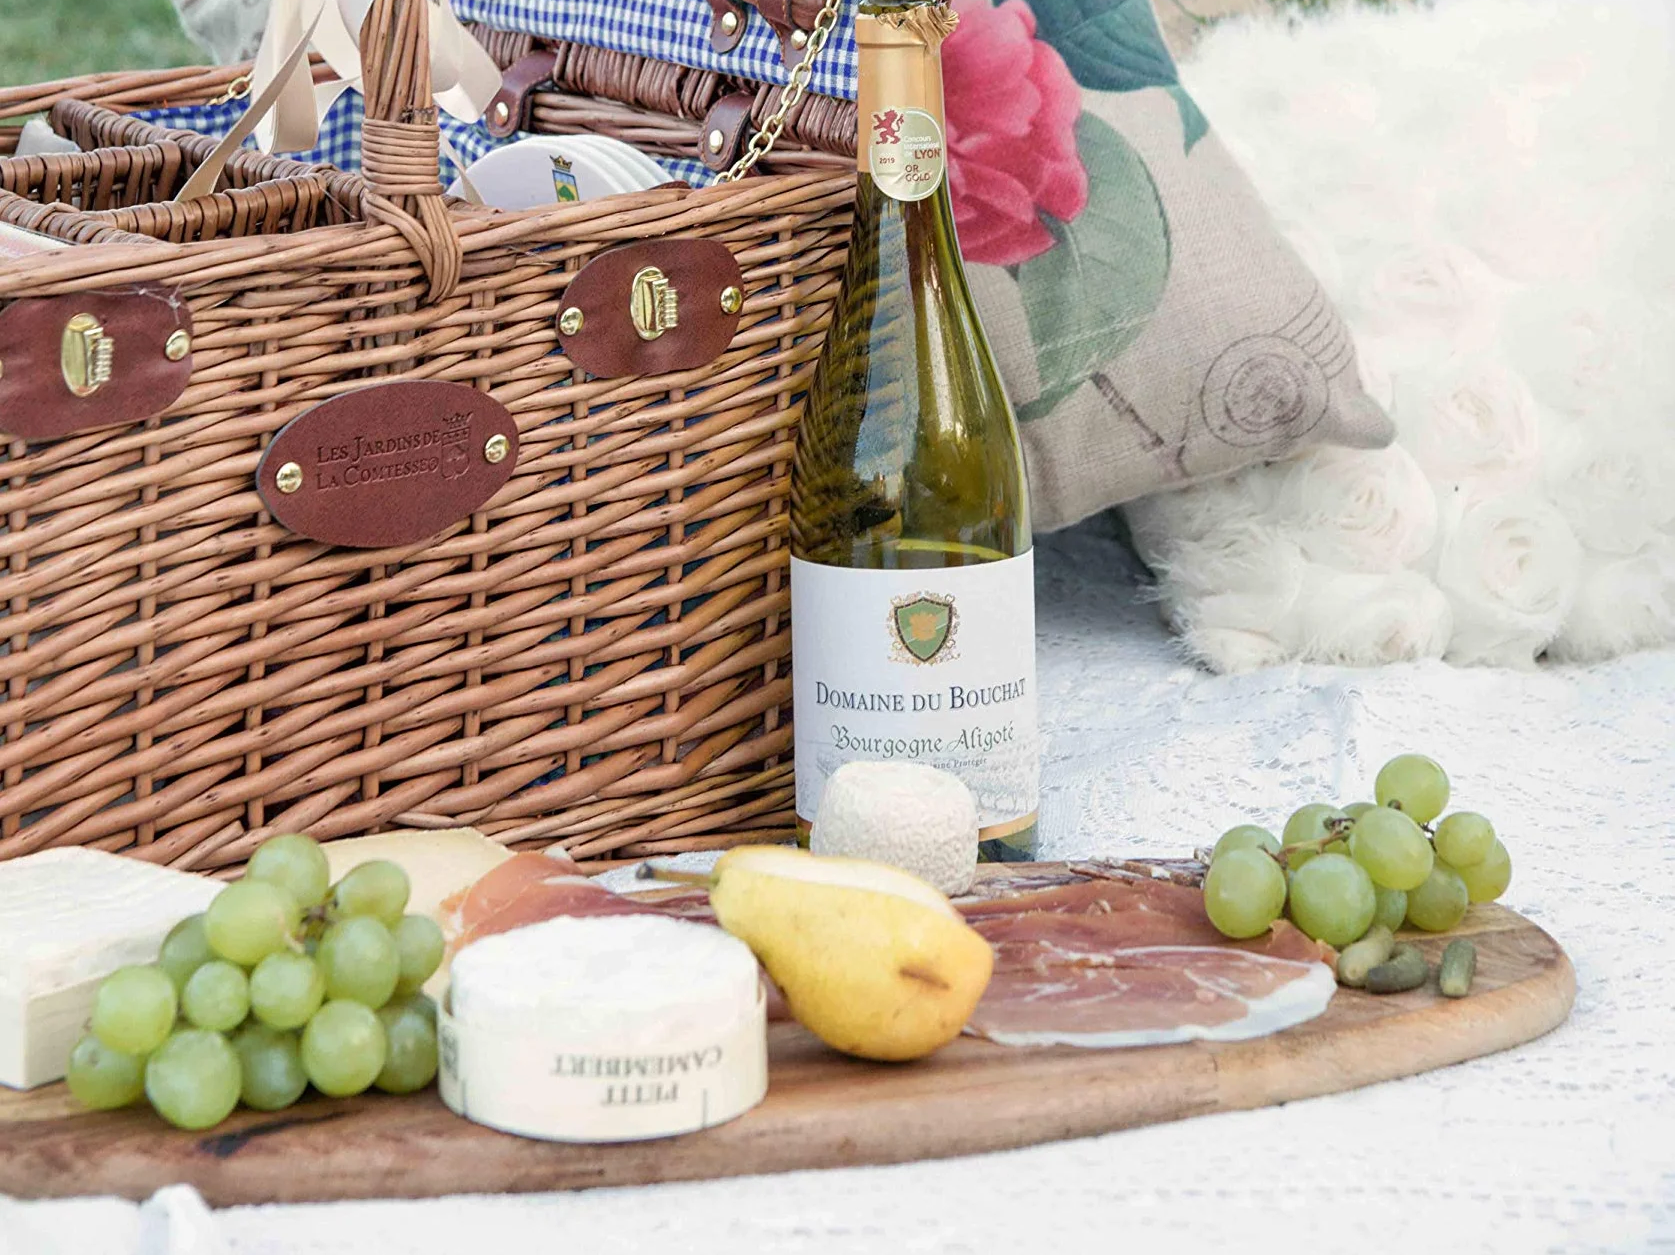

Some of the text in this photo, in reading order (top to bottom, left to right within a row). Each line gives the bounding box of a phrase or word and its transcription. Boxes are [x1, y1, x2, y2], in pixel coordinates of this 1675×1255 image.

[879, 157, 895, 165] 2019
[914, 148, 941, 160] LYON
[905, 165, 919, 173] OR
[905, 173, 931, 182] GOLD
[317, 429, 441, 464] LES JARDINS DE
[317, 473, 339, 490] LA
[815, 681, 904, 712] DOMAINE
[950, 678, 1026, 710] BOUCHAT
[831, 720, 1015, 759] Bourgogne Aligoté
[552, 1045, 723, 1078] CAMEMBERT
[601, 1083, 679, 1107] PETIT
